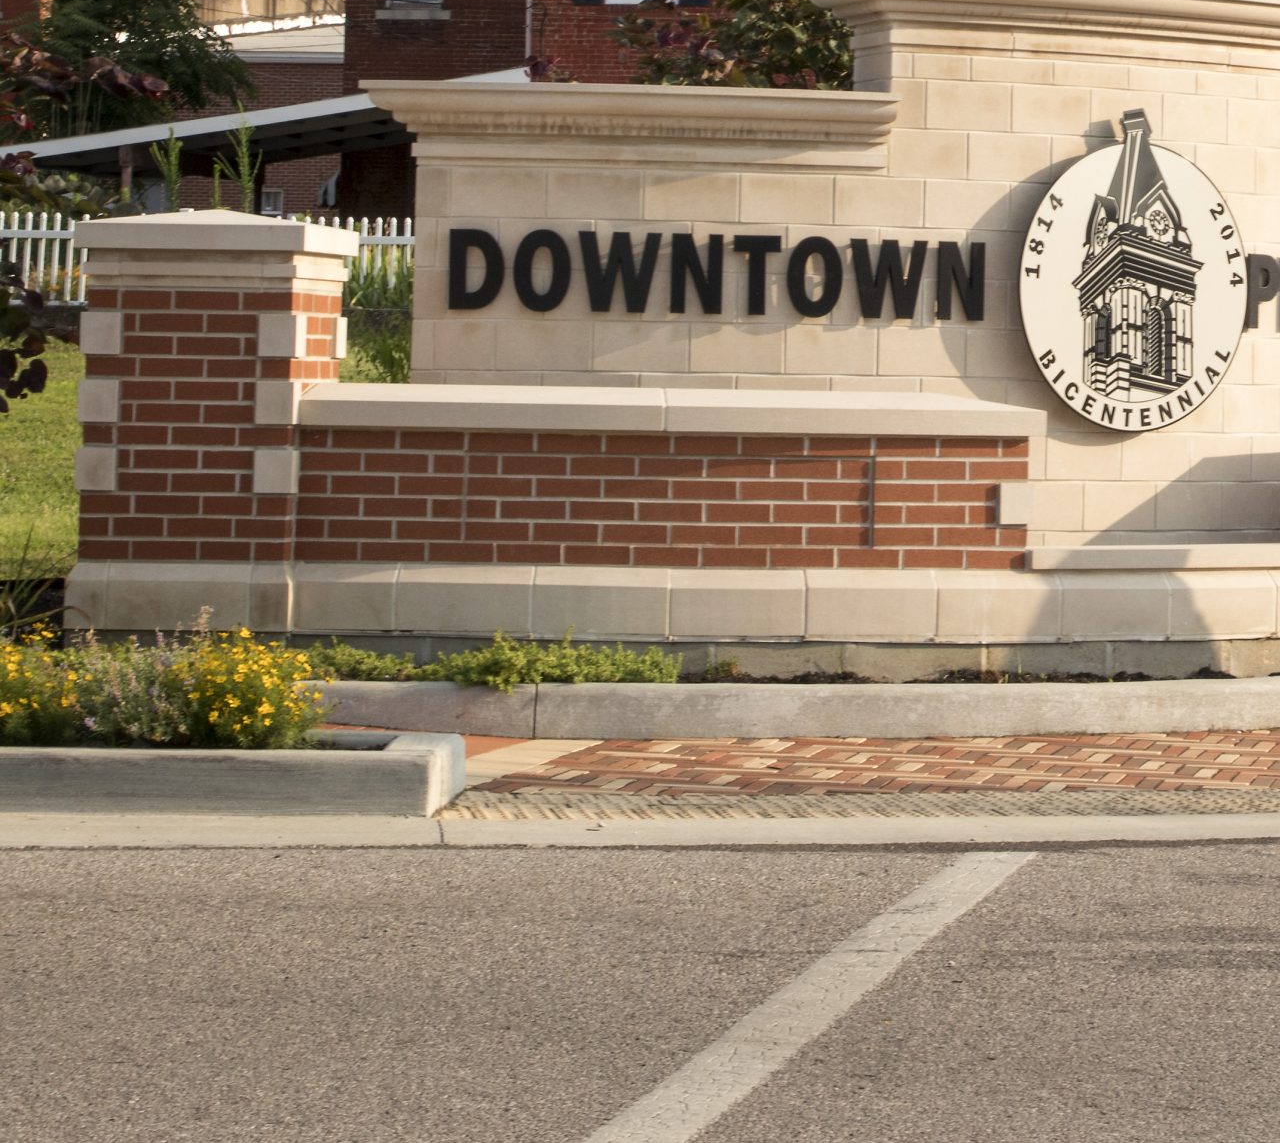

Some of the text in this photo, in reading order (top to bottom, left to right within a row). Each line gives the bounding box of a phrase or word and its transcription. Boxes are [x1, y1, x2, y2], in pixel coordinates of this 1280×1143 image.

[448, 228, 985, 321] DOWNTOWN
[1024, 192, 1064, 279] 1814
[1208, 202, 1244, 288] 2014
[1038, 348, 1231, 427] BICENTENNIAL
